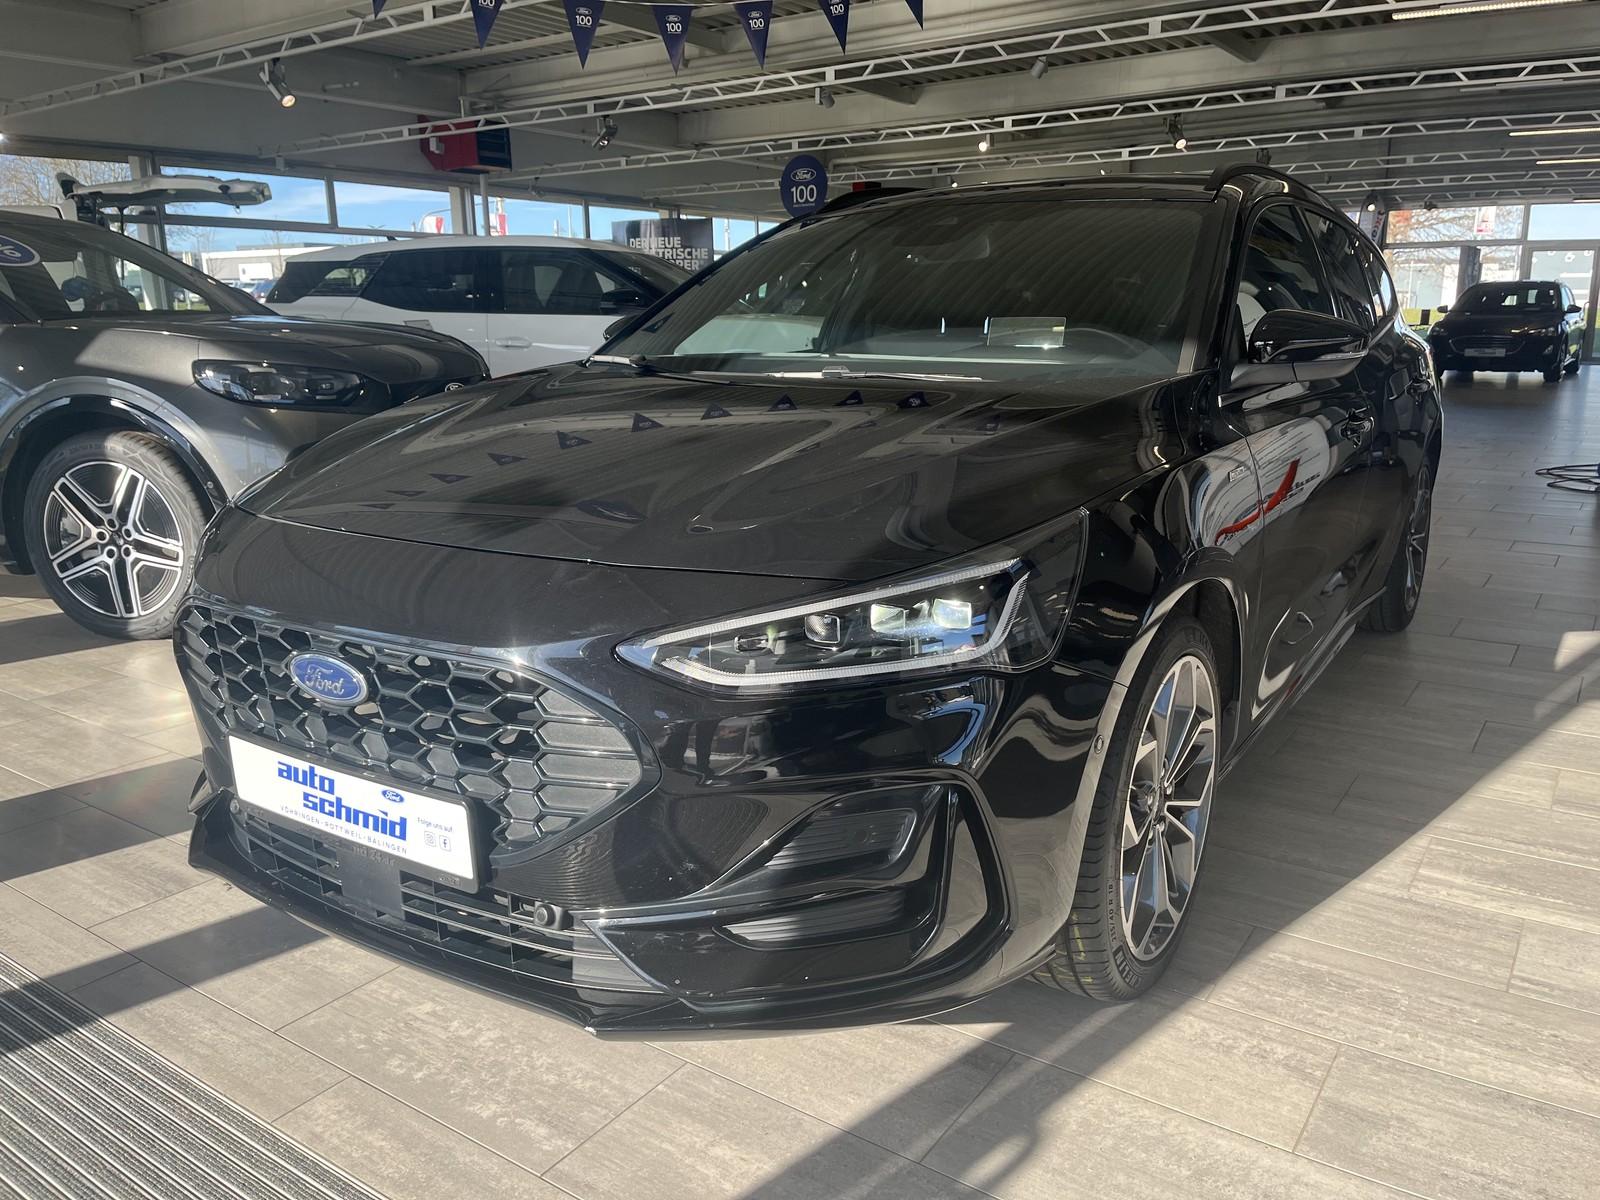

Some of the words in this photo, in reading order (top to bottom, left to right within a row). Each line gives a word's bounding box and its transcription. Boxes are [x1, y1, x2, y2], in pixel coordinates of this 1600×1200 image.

[830, 3, 845, 14] 100
[575, 15, 592, 26] 100
[748, 18, 765, 28] 100
[666, 22, 682, 32] 100
[790, 184, 817, 204] 100
[630, 237, 649, 249] DER
[304, 663, 345, 695] Ford
[277, 761, 335, 795] auto
[302, 791, 407, 841] schmid
